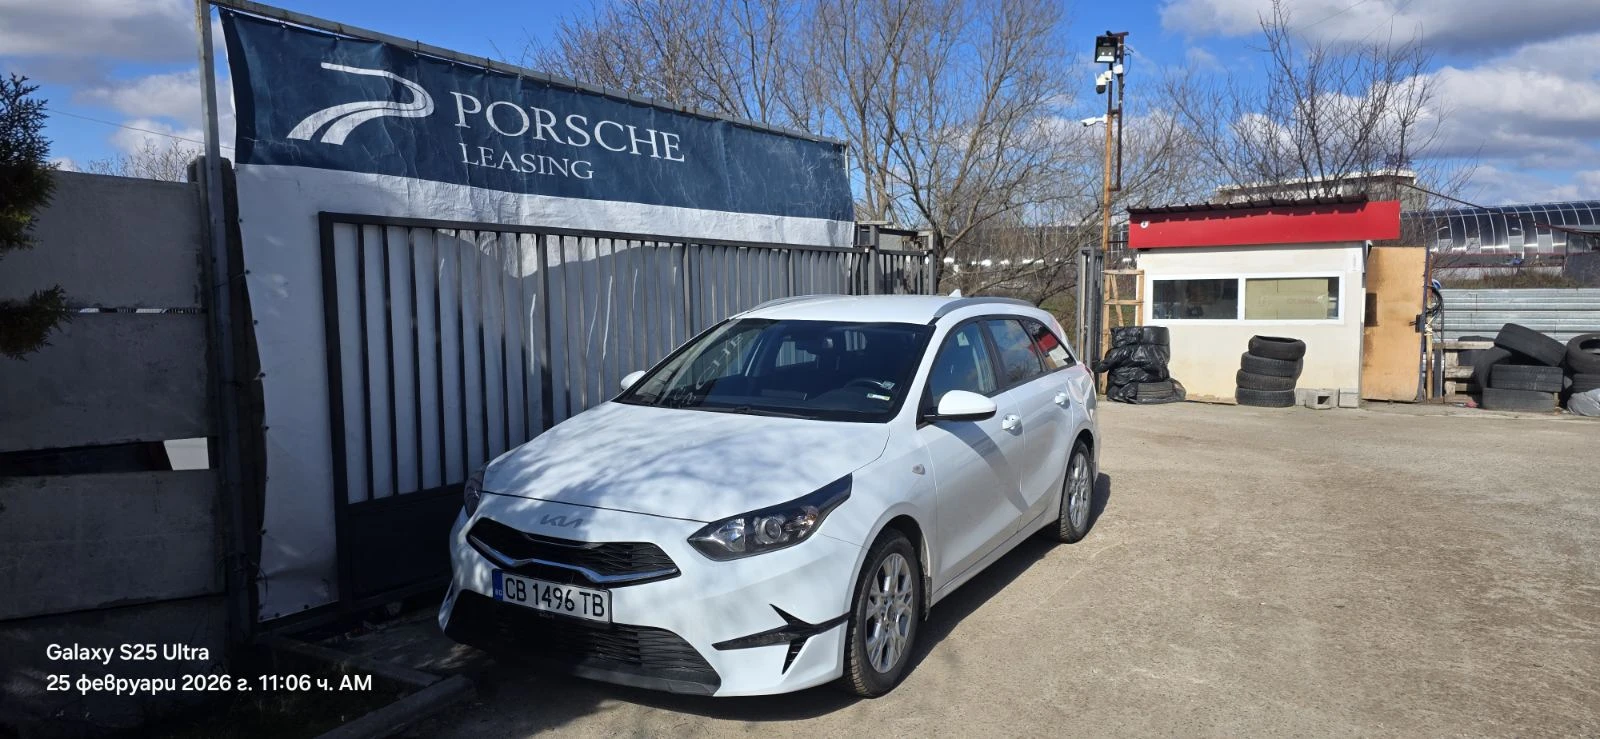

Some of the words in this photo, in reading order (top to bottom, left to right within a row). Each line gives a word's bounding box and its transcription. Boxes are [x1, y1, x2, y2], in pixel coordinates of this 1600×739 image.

[450, 91, 685, 163] PORSCHE
[459, 143, 594, 179] LEASING
[505, 577, 528, 602] CB
[532, 583, 575, 612] 1496
[579, 591, 605, 617] TB
